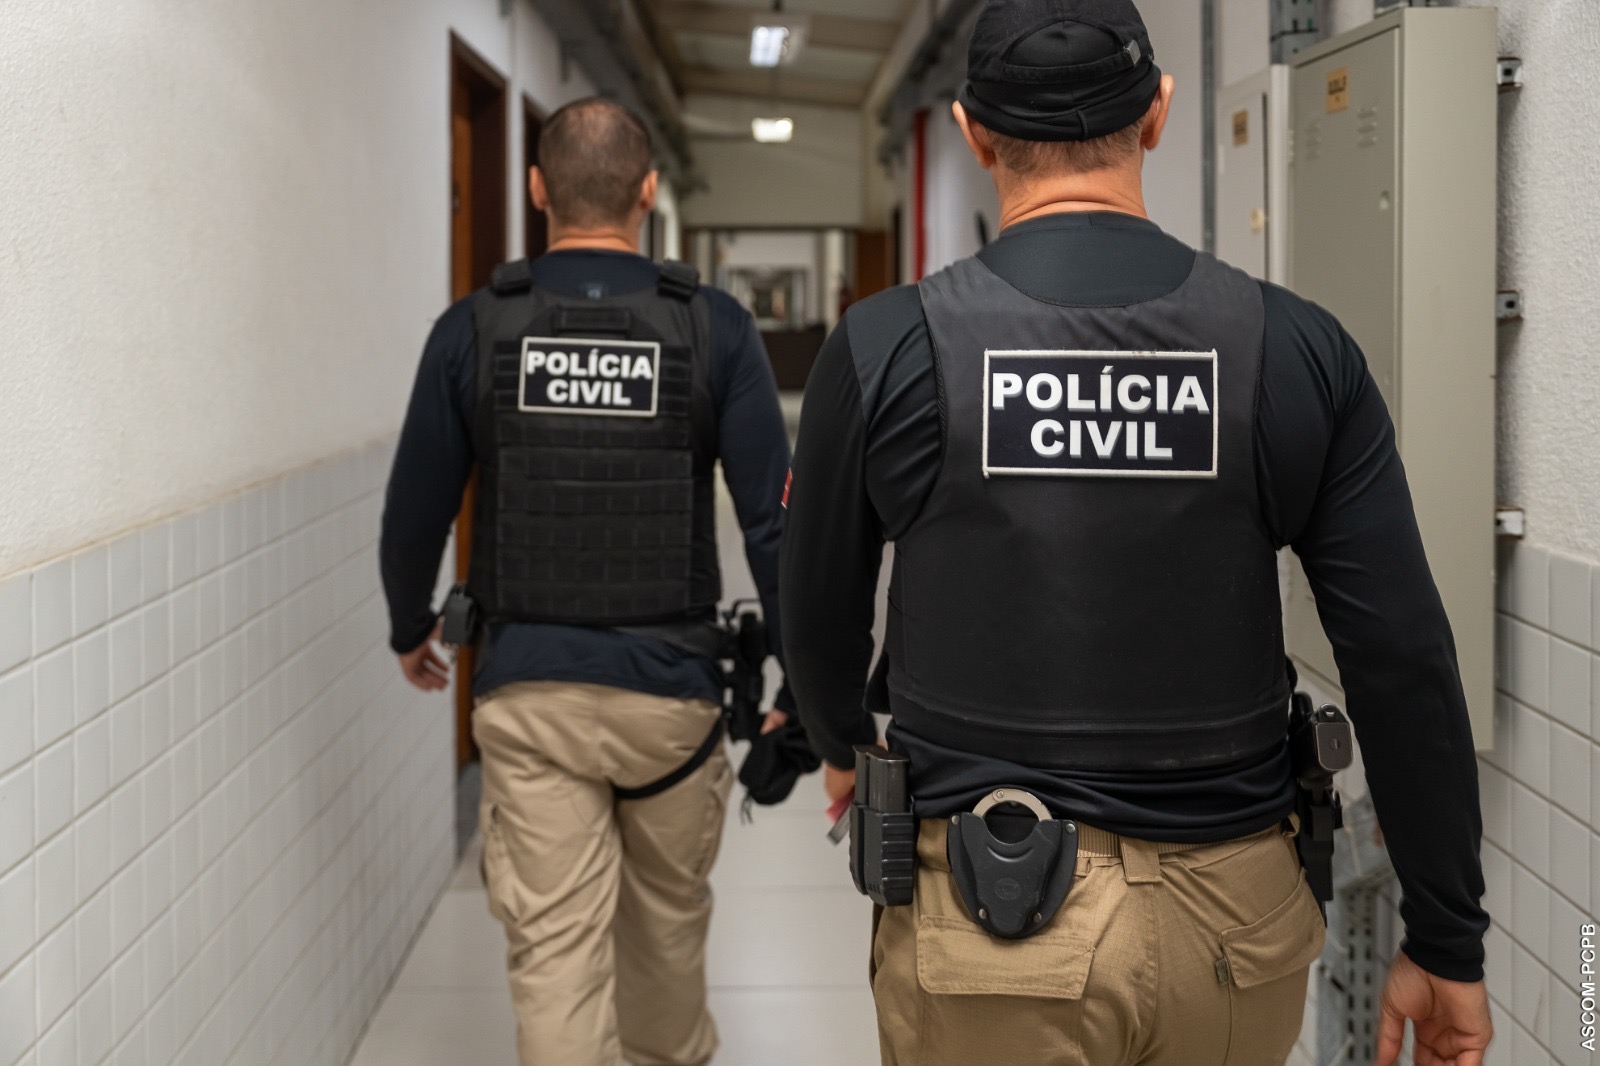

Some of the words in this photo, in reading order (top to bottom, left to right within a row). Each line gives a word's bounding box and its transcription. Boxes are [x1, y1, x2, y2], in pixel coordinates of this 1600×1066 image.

[526, 348, 653, 380] POLÍCIA
[546, 378, 632, 406] CIVIL
[992, 365, 1210, 414] POLÍCIA
[1030, 418, 1173, 460] CIVIL
